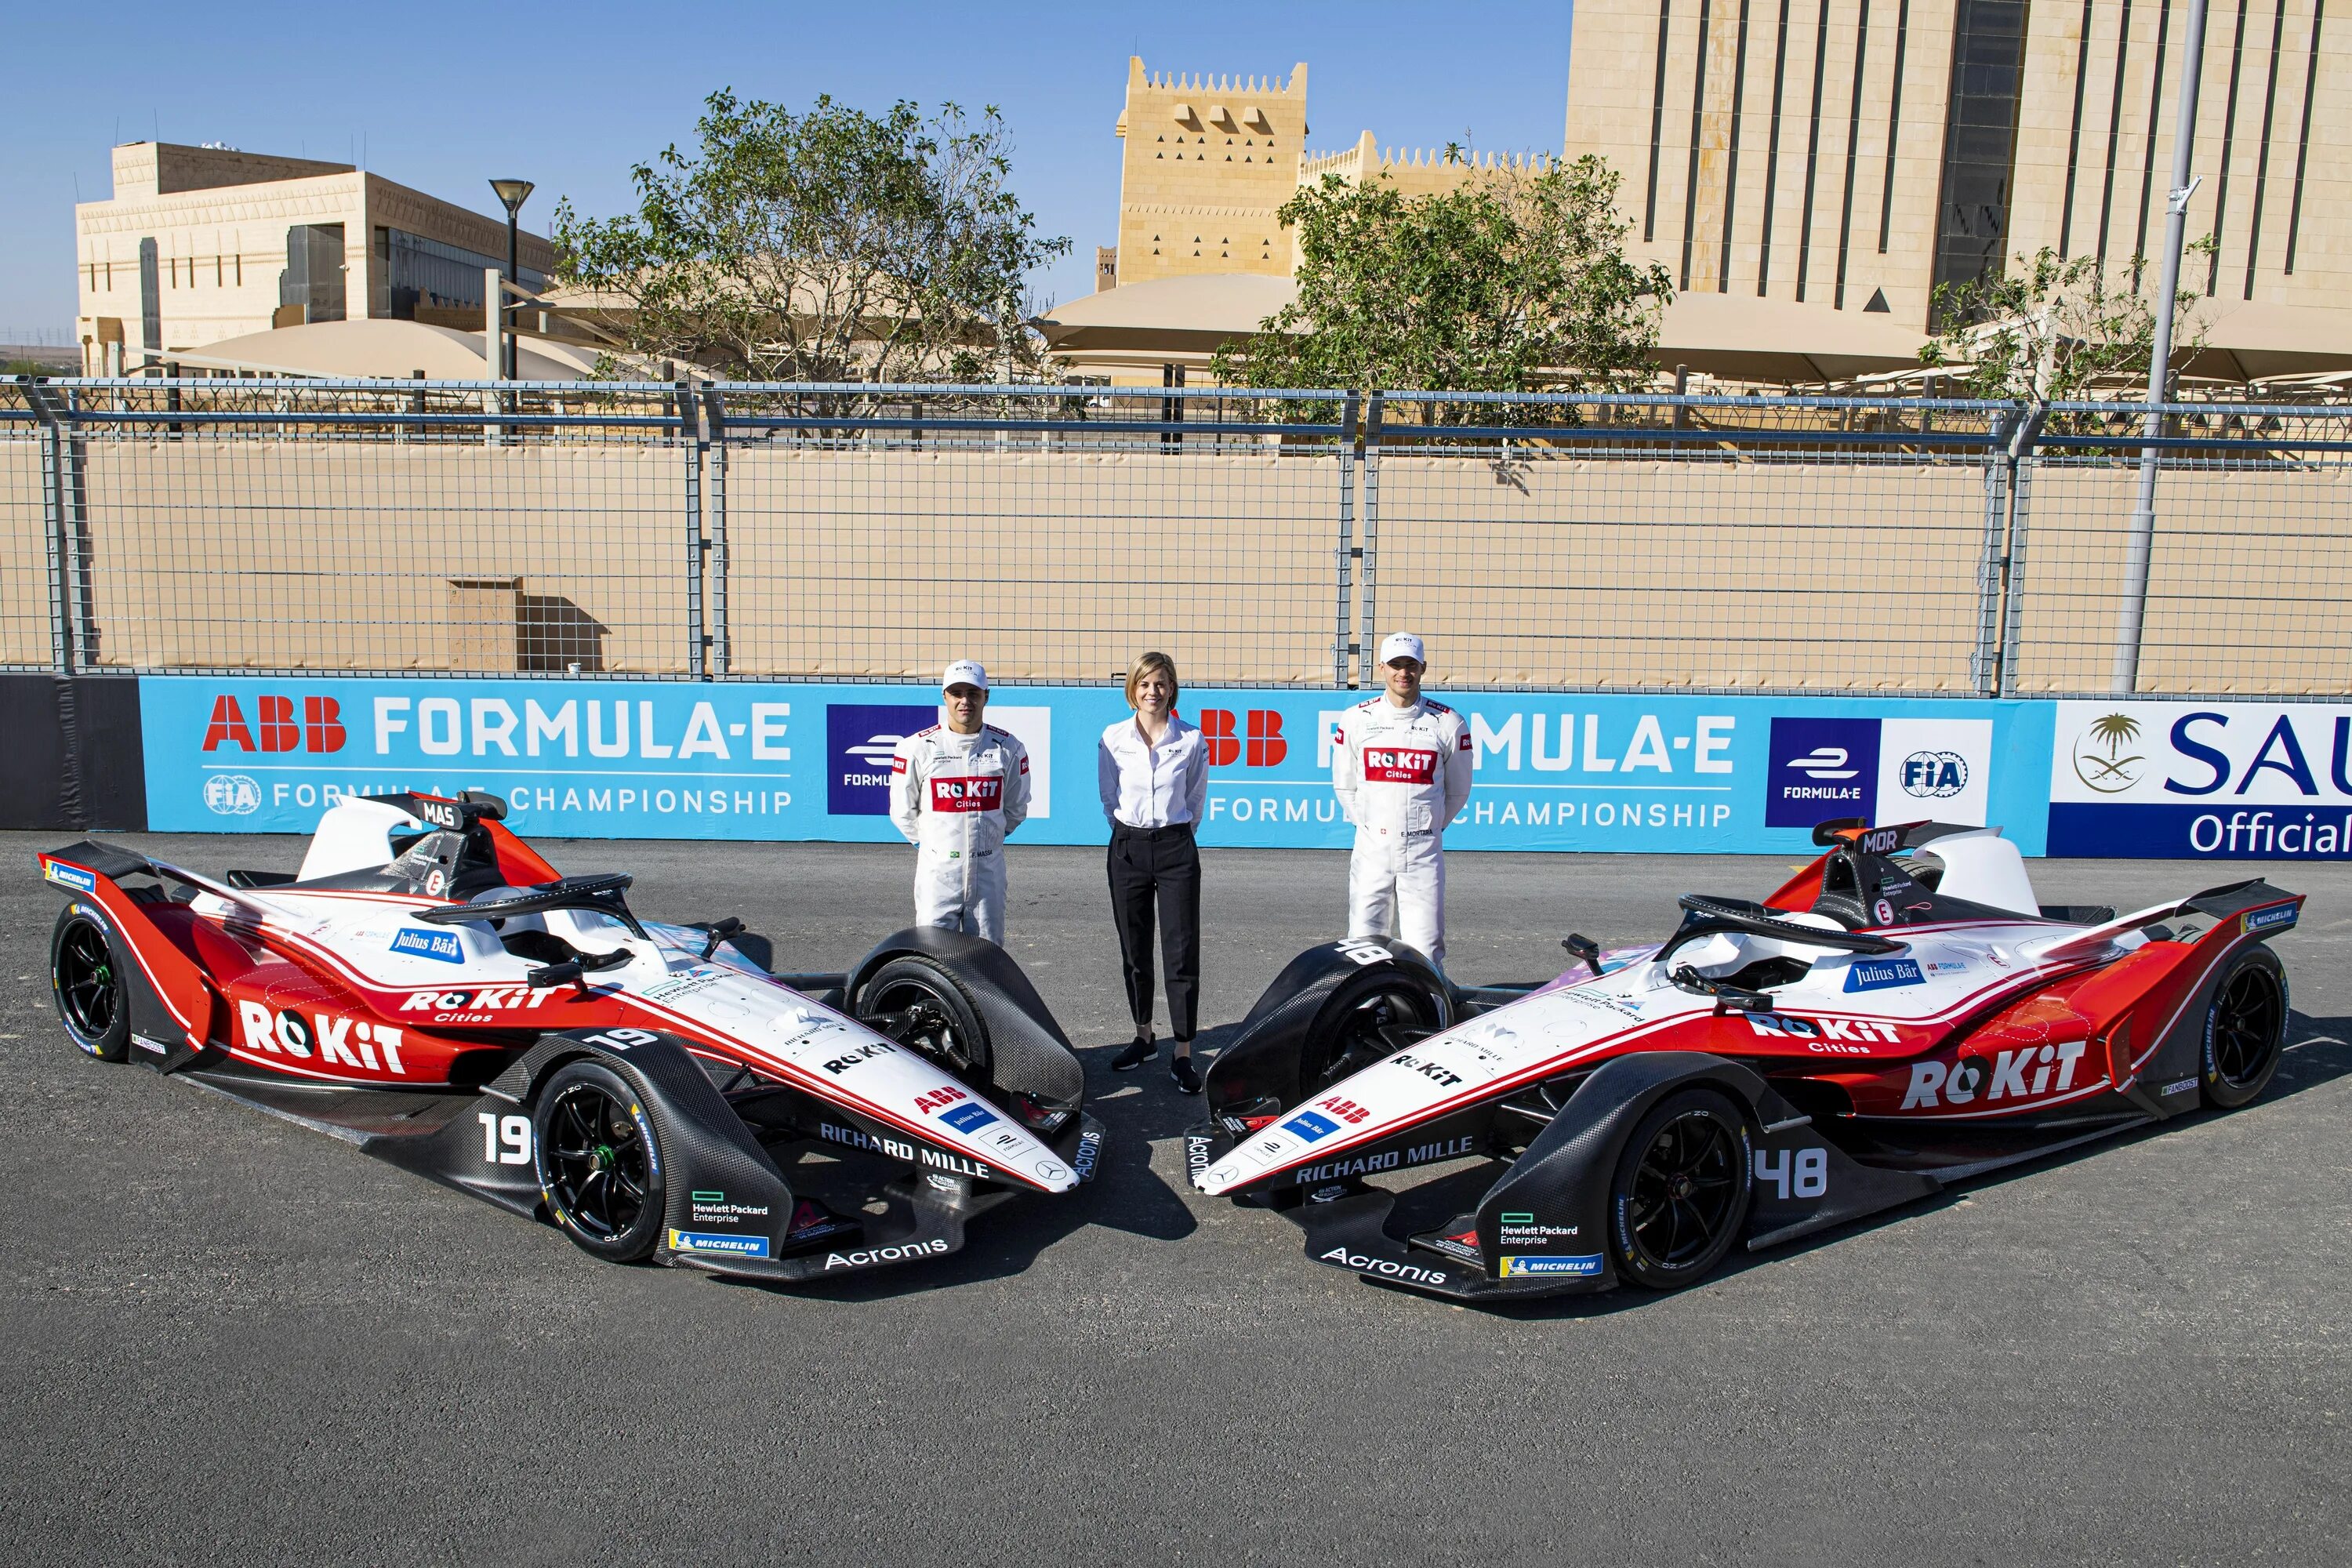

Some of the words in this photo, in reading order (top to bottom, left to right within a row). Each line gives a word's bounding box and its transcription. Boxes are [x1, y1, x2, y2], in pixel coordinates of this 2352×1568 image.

[201, 695, 347, 753] ABB
[1171, 707, 1287, 768] BB
[1385, 771, 1412, 780] Cities
[510, 787, 792, 815] CHAMPIONSHIP
[956, 800, 981, 808] Cities
[424, 802, 455, 826] MAS
[1863, 830, 1898, 854] MOR
[2190, 811, 2352, 853] Official
[59, 870, 92, 887] MICHELIN
[430, 874, 441, 891] E
[80, 905, 108, 931] MICHELIN
[1878, 904, 1889, 922] E
[2256, 909, 2292, 925] MICHELIN
[395, 931, 430, 950] Julius
[1855, 964, 1894, 987] Julius
[1897, 963, 1918, 980] Bär
[653, 982, 699, 1000] Hewlett
[662, 982, 720, 1004] Enterprise
[434, 1012, 494, 1024] Cities
[1599, 1000, 1646, 1022] Packard
[582, 1028, 659, 1051] 19
[784, 1028, 822, 1047] RICHARD
[822, 1022, 848, 1031] MILLE
[2206, 1007, 2216, 1064] MICHELIN
[1479, 1047, 1505, 1062] MILLE
[1807, 1042, 1871, 1055] Cities
[2167, 1077, 2198, 1095] FANBOOST
[913, 1086, 967, 1116] ABB
[1315, 1095, 1370, 1124] ABB
[953, 1112, 974, 1127] Julius
[1295, 1116, 1313, 1129] Julius
[1311, 1123, 1325, 1135] Bär
[478, 1112, 532, 1166] 19
[639, 1122, 658, 1171] MICHELIN
[820, 1122, 913, 1161] RICHARD
[921, 1148, 989, 1179] MILLE
[1073, 1131, 1101, 1177] Acronis
[1296, 1149, 1399, 1184] RICHARD
[1407, 1136, 1473, 1163] MILLE
[1755, 1147, 1828, 1200] 48
[692, 1203, 730, 1214] Hewlett
[731, 1205, 768, 1215] Packard
[692, 1213, 739, 1224] Enterprise
[1501, 1225, 1538, 1236] Hewlett
[1539, 1225, 1578, 1236] Packard
[1618, 1198, 1629, 1245] MICHELIN
[695, 1239, 760, 1252] MICHELIN
[1500, 1235, 1548, 1246] Enterprise
[824, 1238, 949, 1271] Acronis
[1319, 1247, 1447, 1285] Acronis
[1530, 1261, 1596, 1272] MICHELIN
